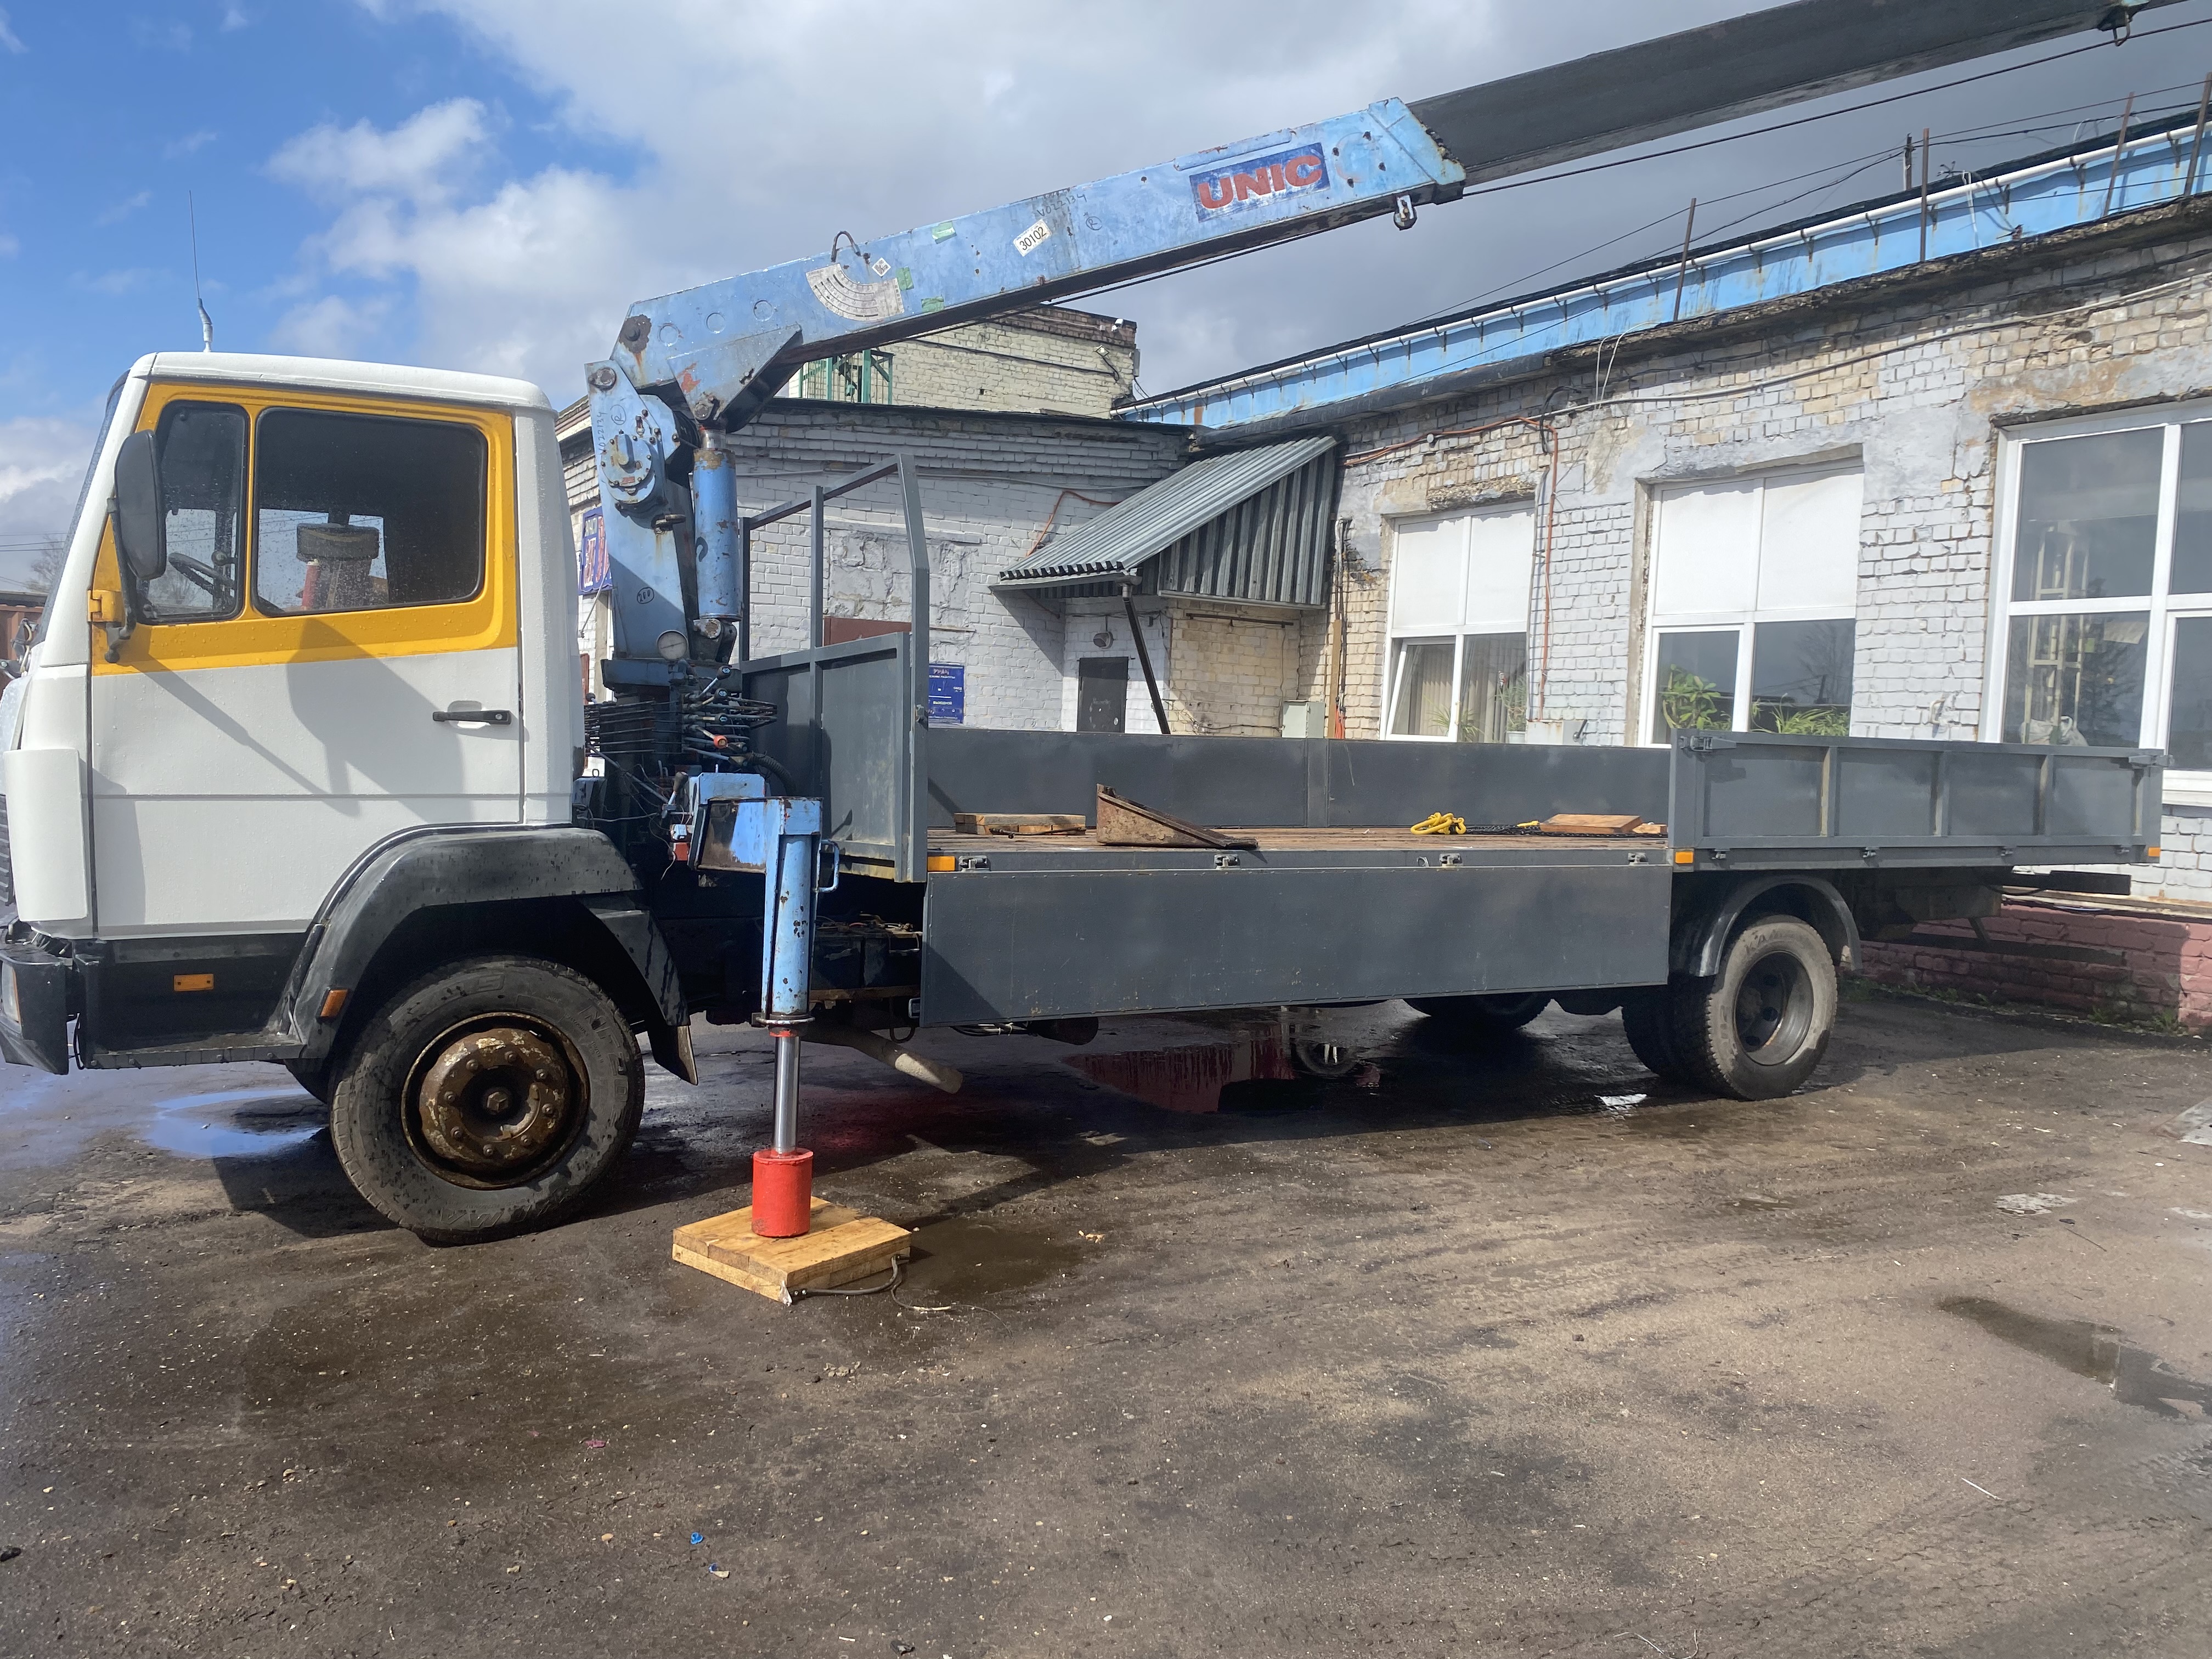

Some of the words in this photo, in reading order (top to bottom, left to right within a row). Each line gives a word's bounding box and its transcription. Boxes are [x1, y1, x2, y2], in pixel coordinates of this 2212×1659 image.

[1198, 155, 1323, 210] UNIC
[1036, 193, 1087, 217] V022134
[1019, 227, 1047, 251] 30102
